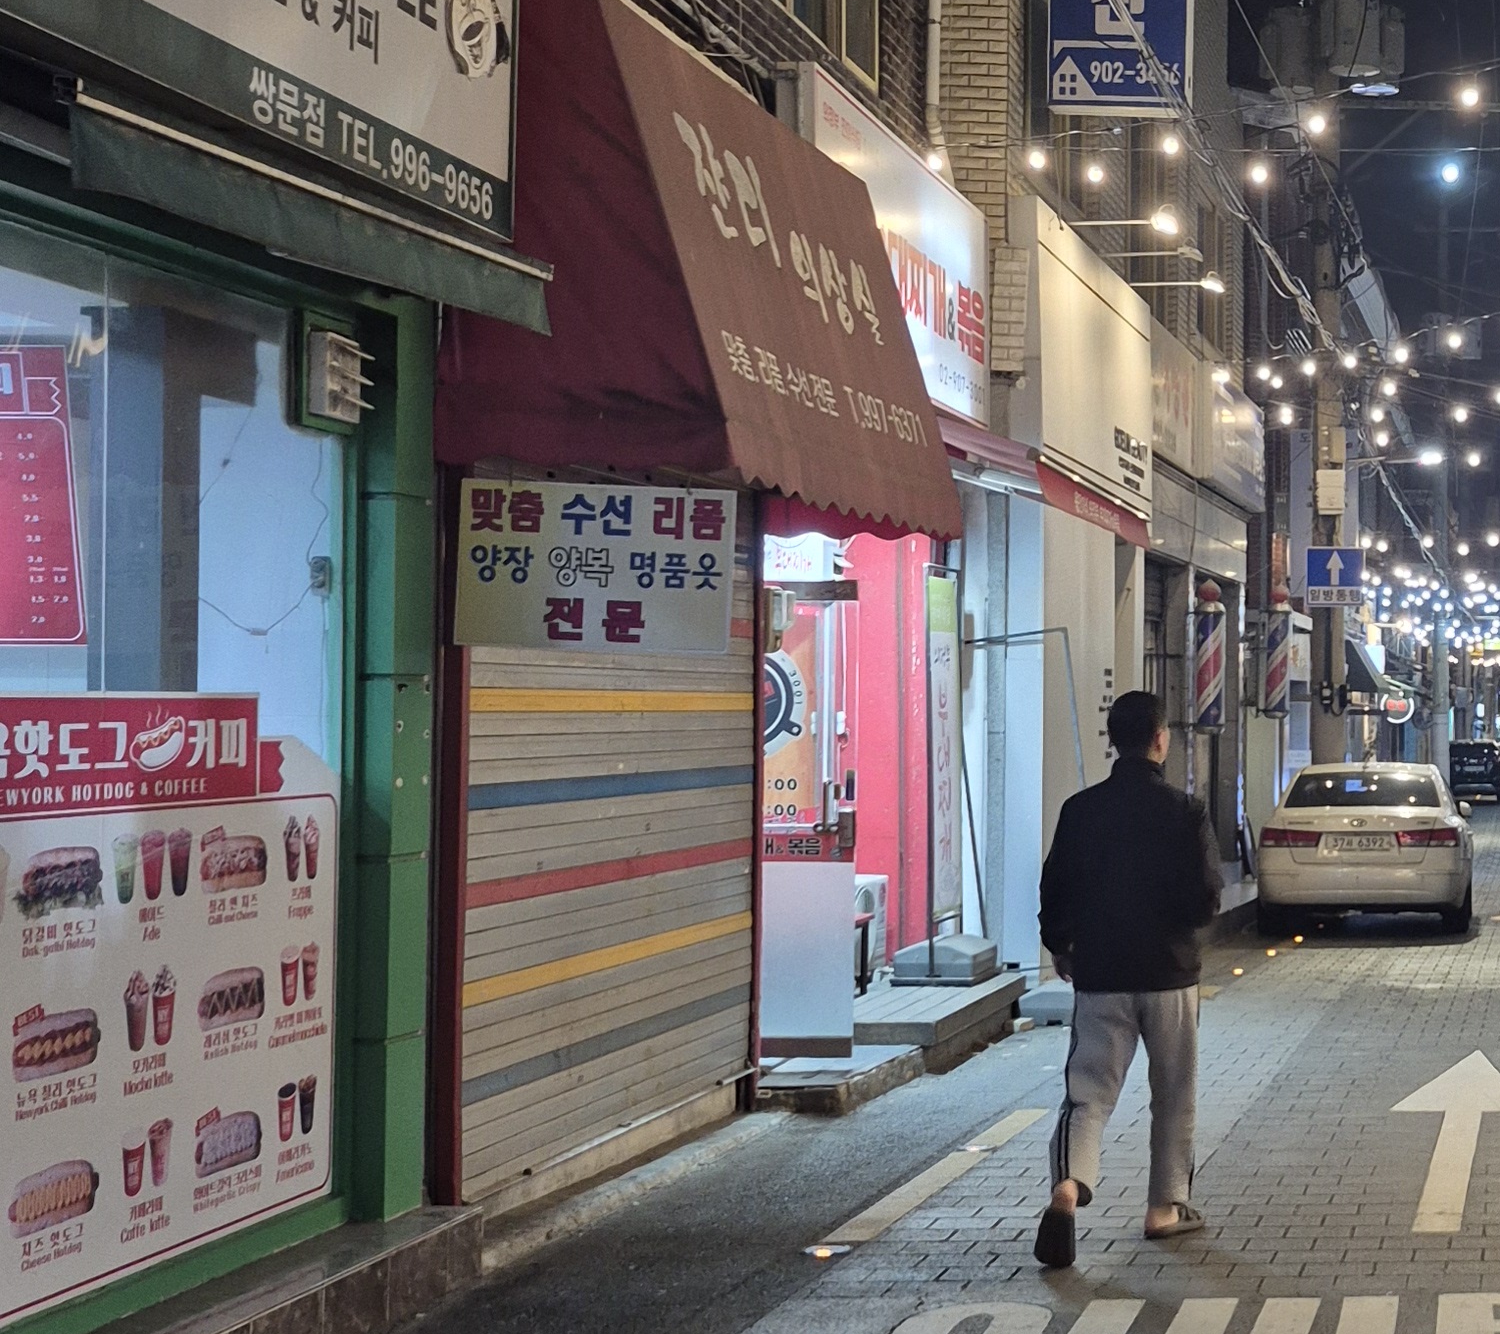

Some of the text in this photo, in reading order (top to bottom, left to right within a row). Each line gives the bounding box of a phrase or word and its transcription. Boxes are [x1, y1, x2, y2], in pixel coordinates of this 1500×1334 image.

[249, 65, 326, 149] 쌍문점
[789, 230, 885, 346] 의상실
[470, 489, 726, 541] 맞춤 수선 리폼
[471, 544, 534, 584] 양장
[548, 546, 614, 587] 양복
[1310, 586, 1362, 603] 일방통행
[543, 597, 645, 643] 전문
[187, 717, 248, 769] 커피
[72, 781, 135, 803] HOTDOG
[155, 777, 208, 798] COFFEE
